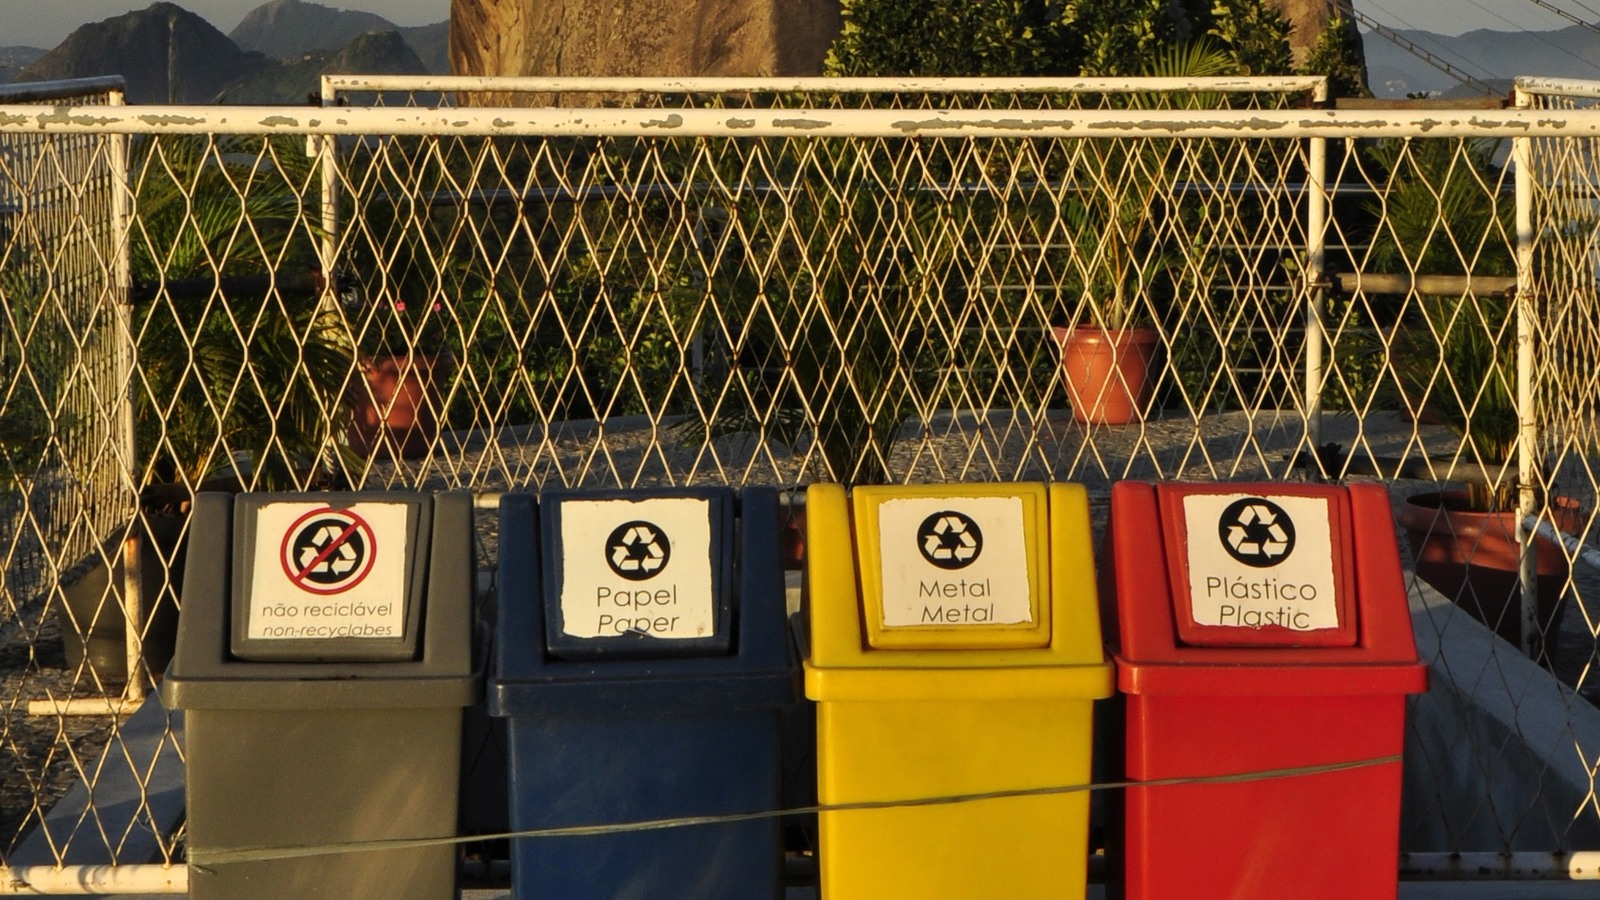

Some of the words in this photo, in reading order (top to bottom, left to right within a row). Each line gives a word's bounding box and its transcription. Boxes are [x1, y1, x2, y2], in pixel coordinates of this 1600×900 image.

[597, 584, 677, 611] Papel
[919, 578, 991, 598] Metal
[1206, 576, 1317, 601] Plástico
[262, 603, 298, 617] não
[303, 602, 392, 617] reciclável
[921, 603, 994, 623] Metal
[1219, 605, 1310, 629] Plastic
[263, 624, 392, 638] non-recyclabes
[598, 614, 680, 634] Paper
